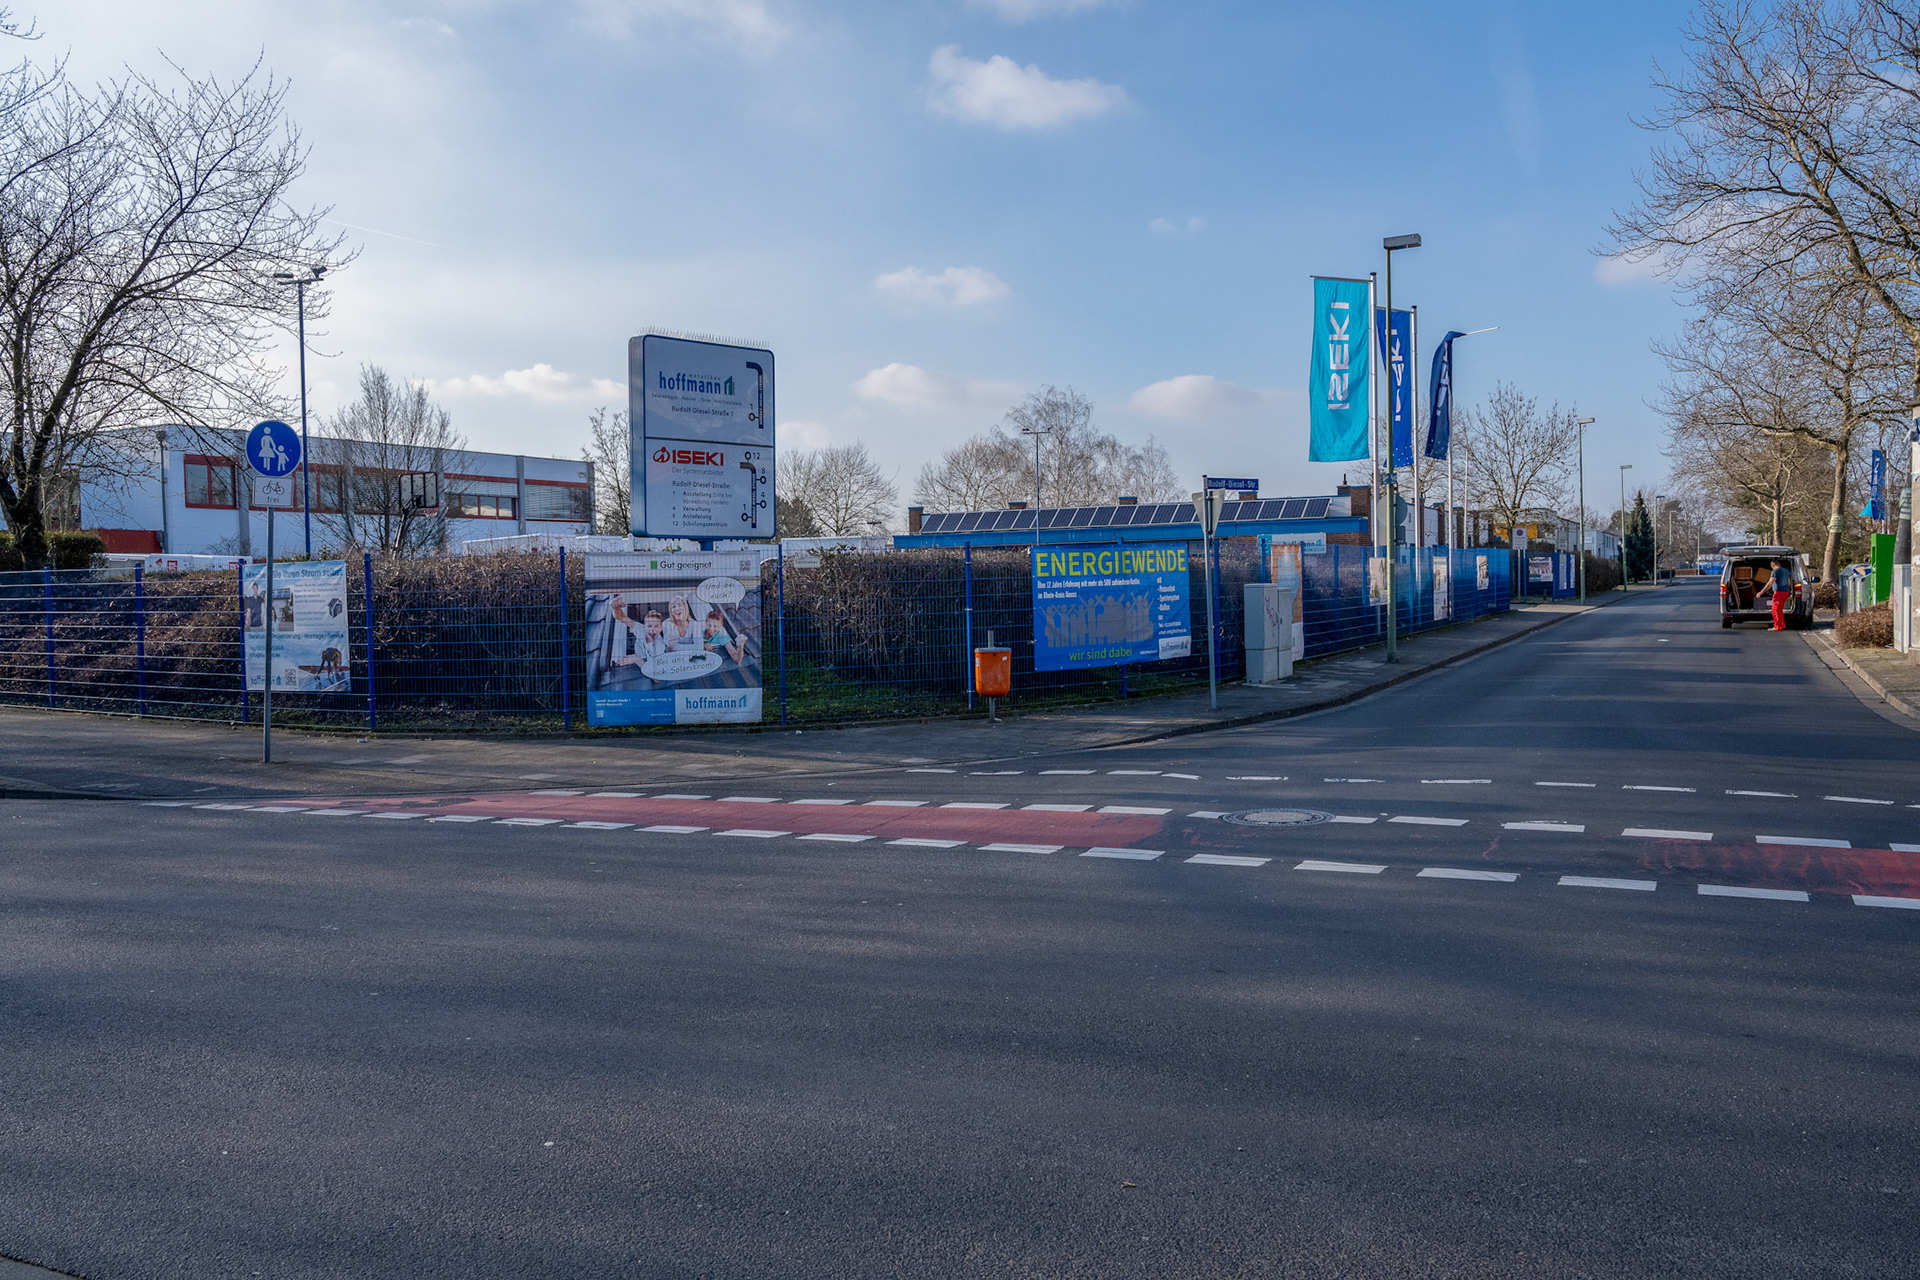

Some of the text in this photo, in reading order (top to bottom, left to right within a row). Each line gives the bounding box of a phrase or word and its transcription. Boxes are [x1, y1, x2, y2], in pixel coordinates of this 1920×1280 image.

[659, 371, 721, 394] hoffmann
[671, 405, 730, 417] Rudolf-Diesel-Straße
[672, 449, 724, 467] ISEKI
[752, 452, 761, 460] 12
[683, 467, 724, 477] Systemanbieter
[761, 467, 766, 475] 8
[760, 491, 766, 499] 4
[267, 496, 280, 504] frei
[682, 505, 712, 514] Verwaltung
[682, 513, 713, 521] Anlieferung
[682, 520, 728, 529] Schulungszentrum
[660, 560, 712, 571] Gut geeignet
[1036, 550, 1186, 577] ENERGIEWENDE
[301, 569, 321, 577] Strom
[706, 582, 721, 590] Und
[710, 591, 733, 600] euch?
[1069, 651, 1085, 661] wir
[1087, 649, 1107, 660] sind
[1109, 646, 1133, 658] dabei
[671, 661, 716, 674] Solarstrom!
[685, 696, 737, 710] hoffmann
